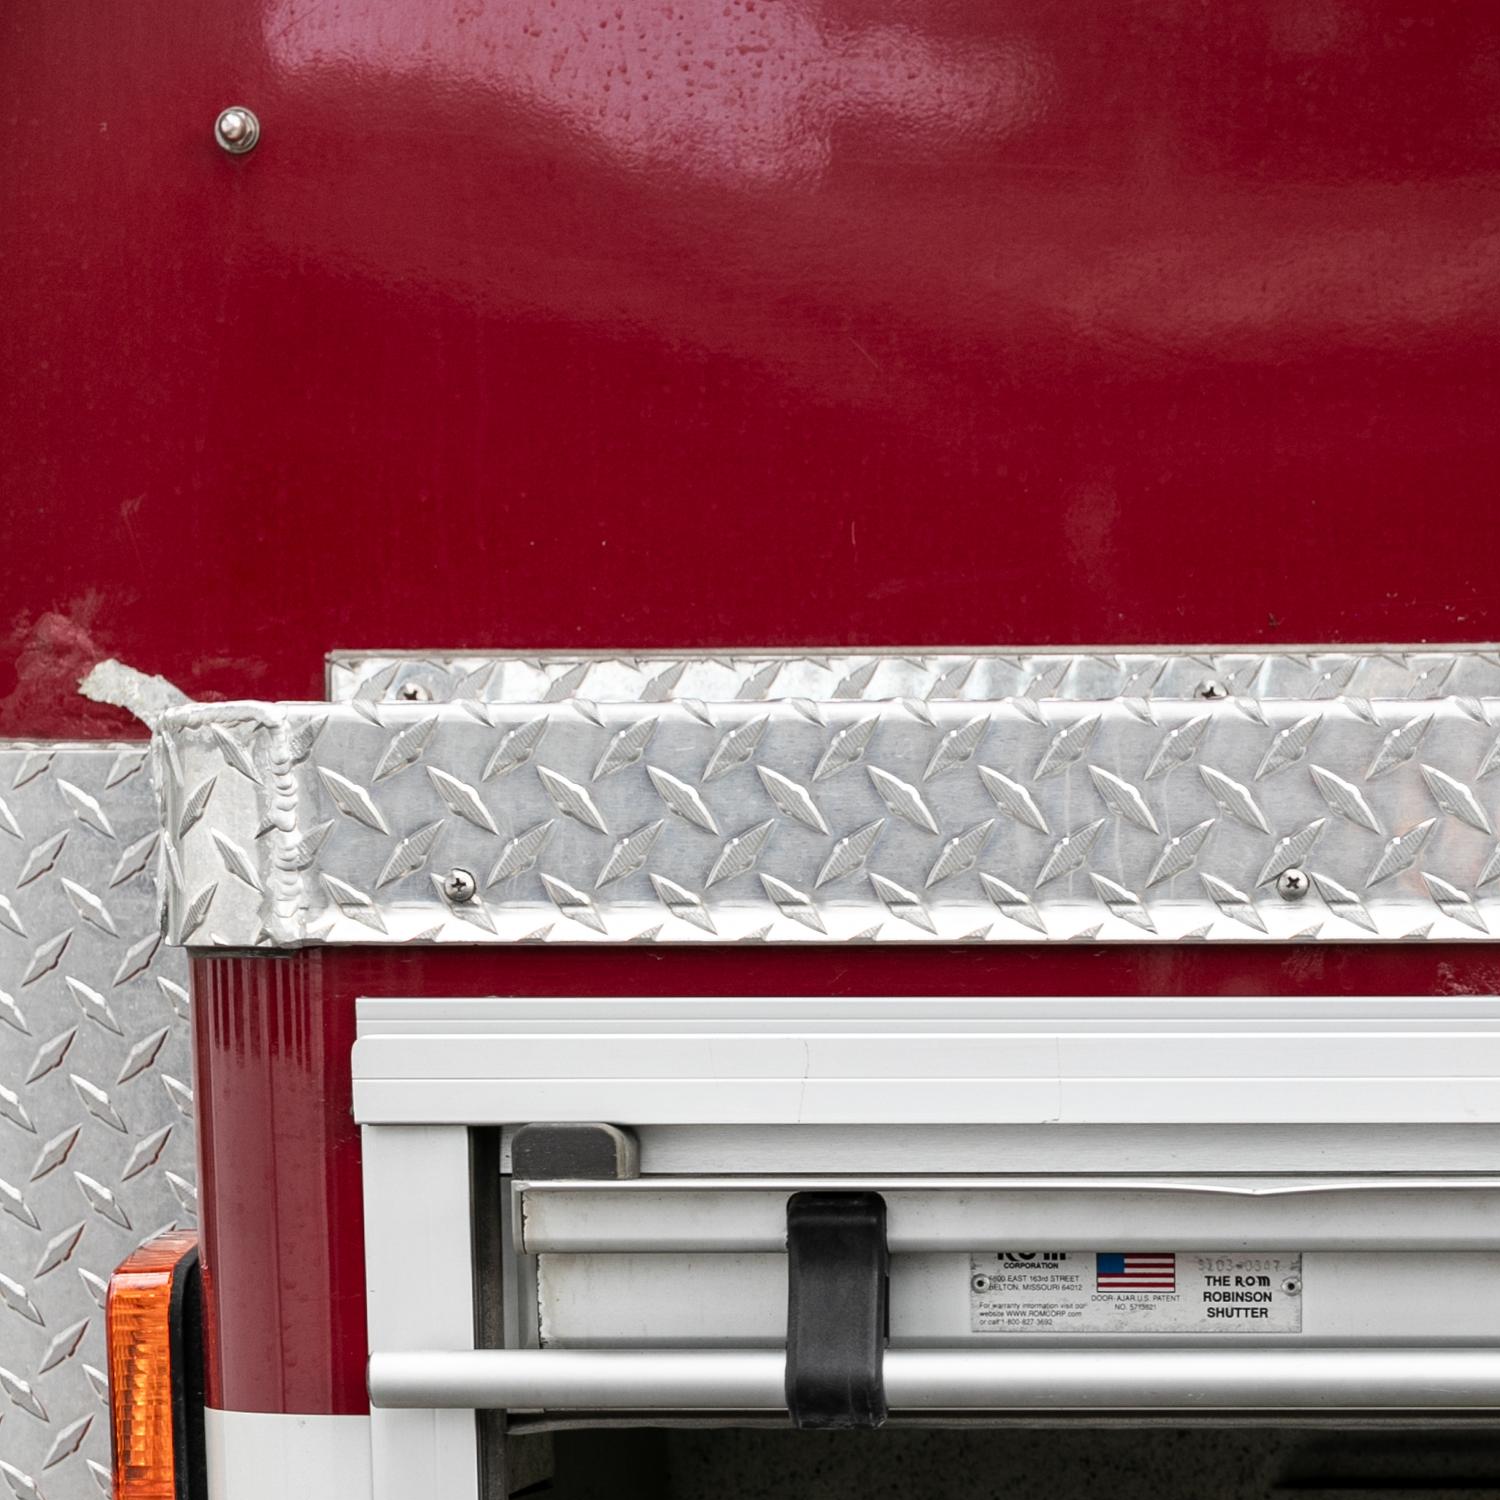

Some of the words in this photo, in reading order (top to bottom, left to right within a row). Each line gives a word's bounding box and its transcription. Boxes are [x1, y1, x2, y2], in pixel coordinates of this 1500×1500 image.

[1204, 1276, 1231, 1286] THE
[1203, 1292, 1272, 1303] ROBINSON
[1207, 1307, 1268, 1318] SHUTTER
